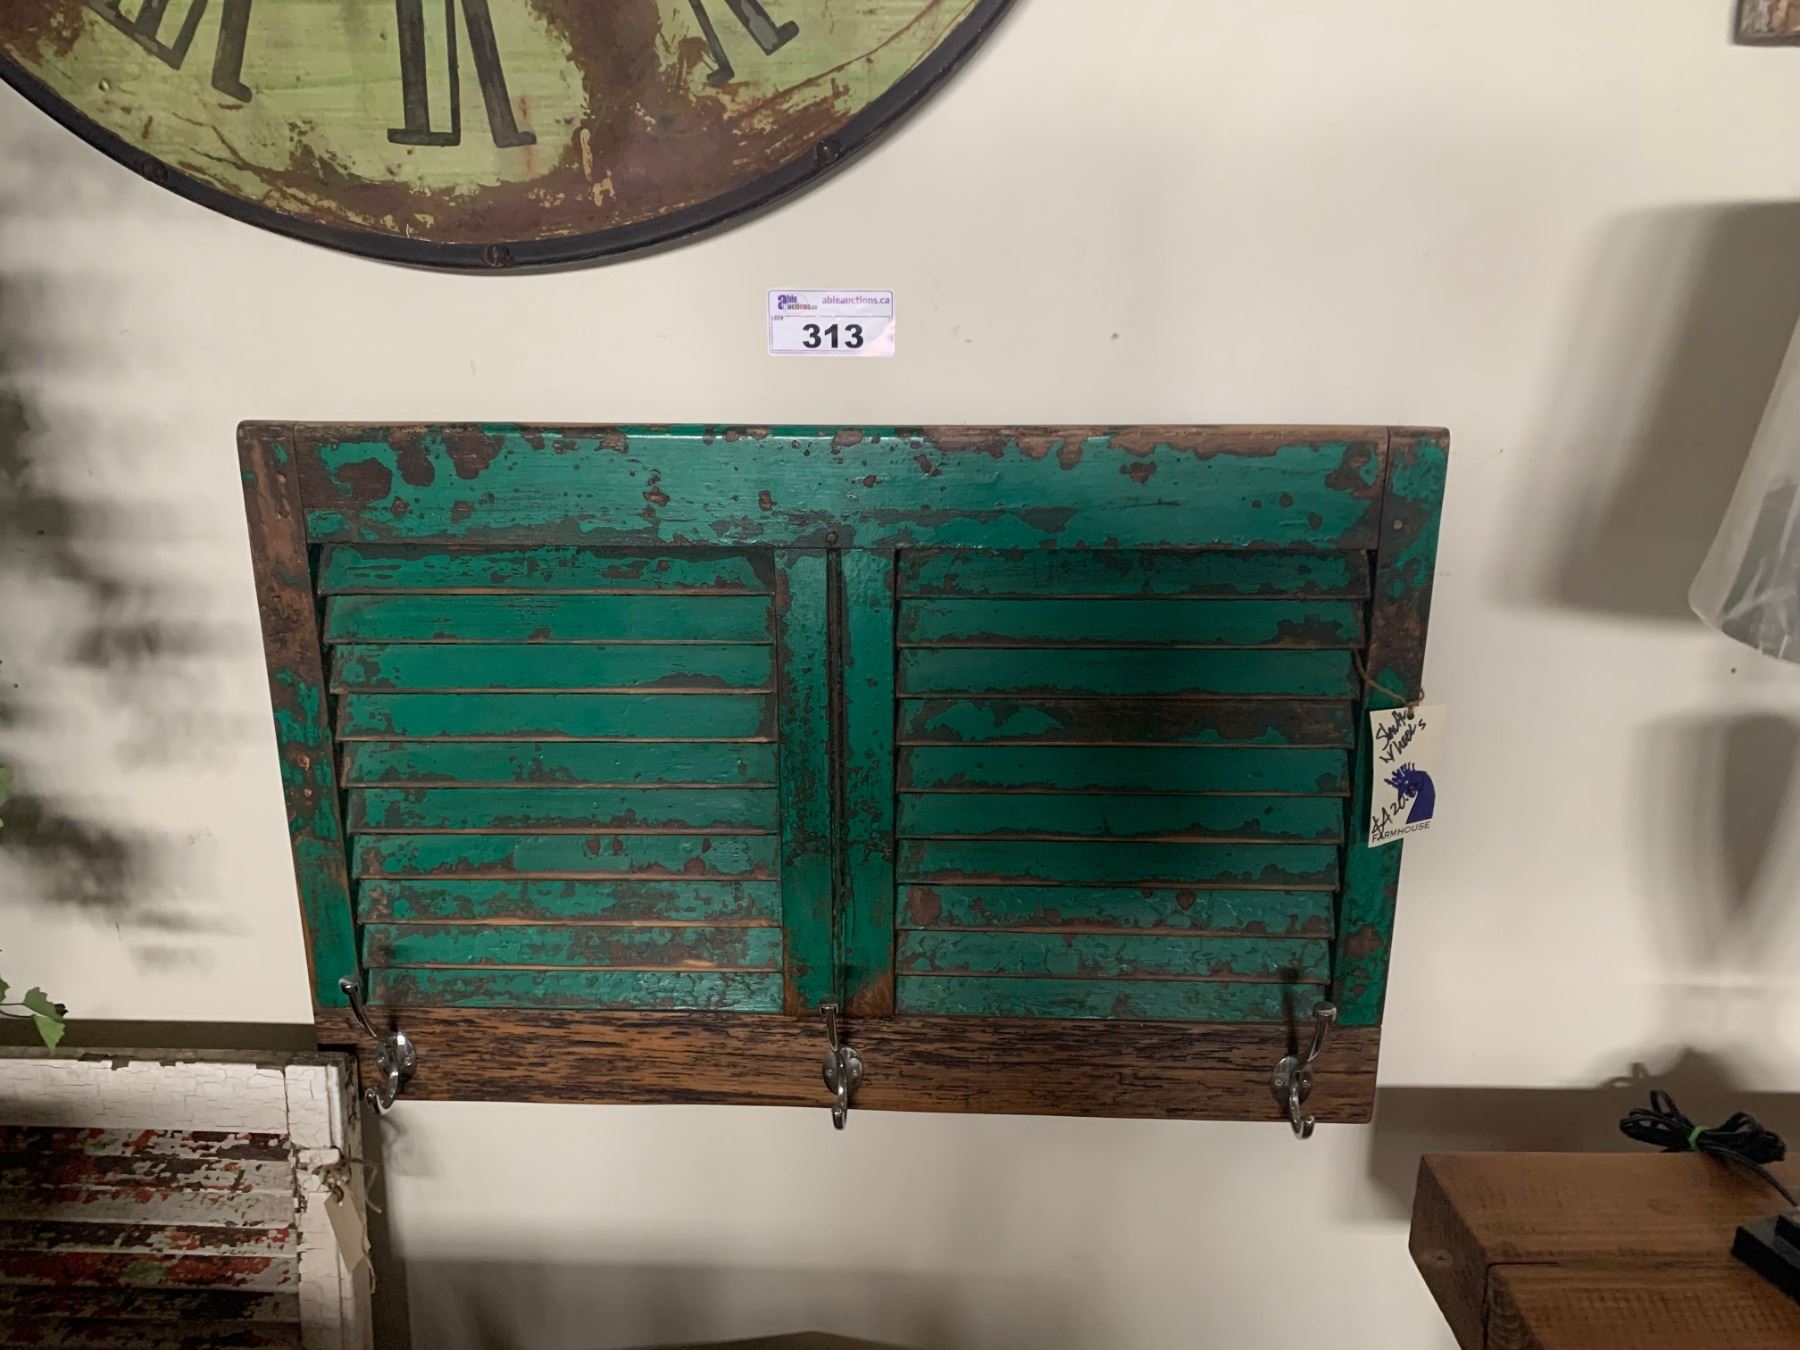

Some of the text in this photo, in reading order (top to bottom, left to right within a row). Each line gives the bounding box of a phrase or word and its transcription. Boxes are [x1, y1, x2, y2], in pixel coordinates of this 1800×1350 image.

[821, 295, 890, 305] ableauctions.ca
[802, 323, 864, 349] 313
[1372, 820, 1432, 843] FARMHOUSE
